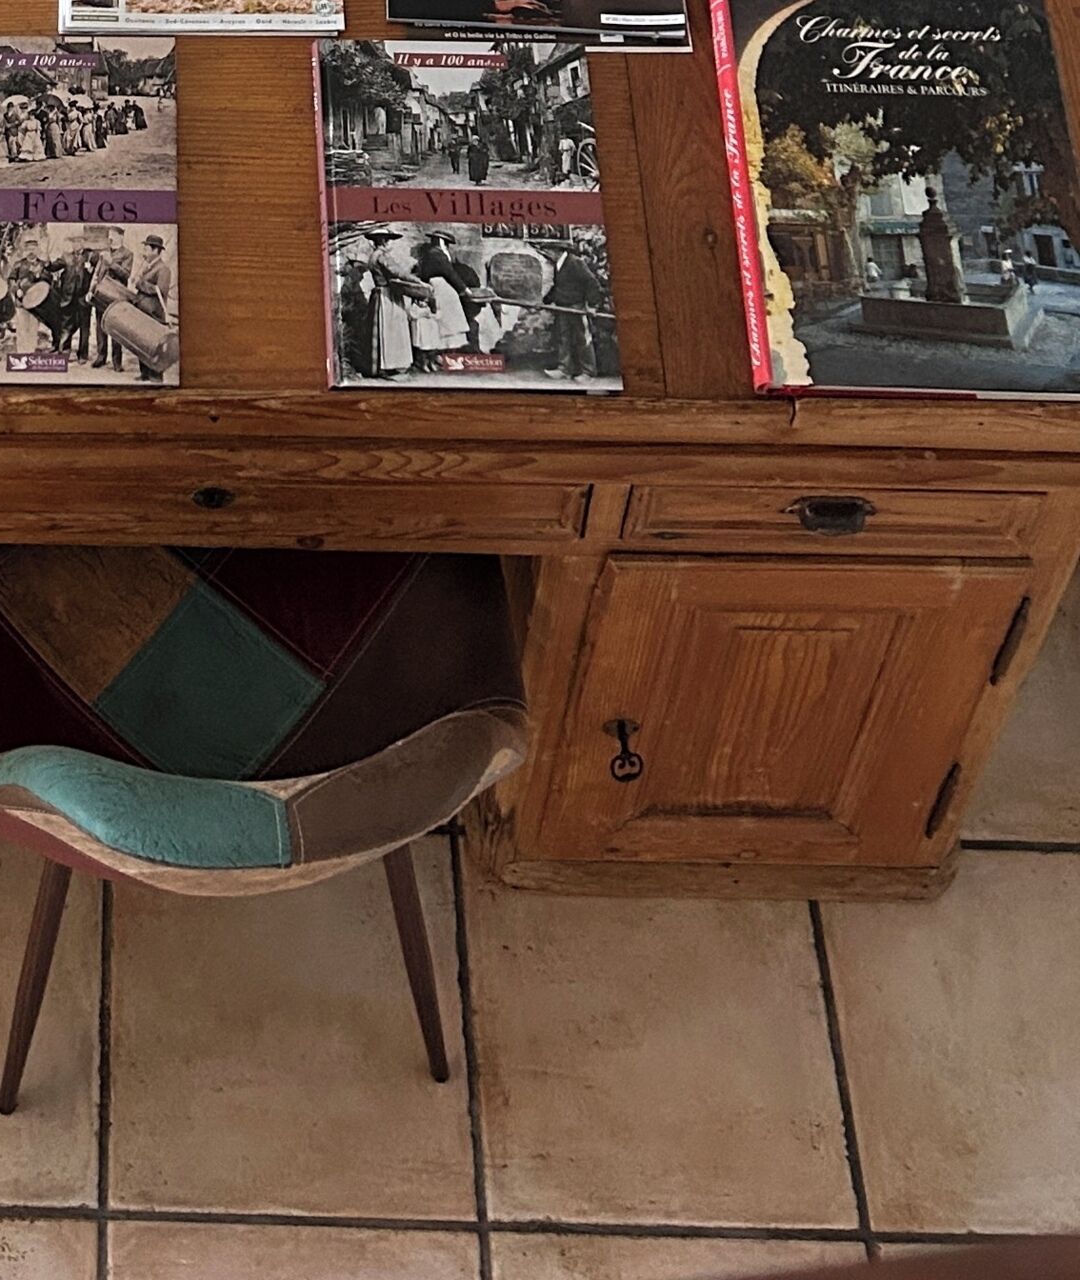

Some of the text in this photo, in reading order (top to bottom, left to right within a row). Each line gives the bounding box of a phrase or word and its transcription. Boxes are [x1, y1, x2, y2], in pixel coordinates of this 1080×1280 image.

[796, 14, 1002, 44] Charmes et secrets
[5, 58, 15, 68] y
[18, 58, 27, 67] a
[32, 54, 57, 67] 100
[396, 53, 410, 66] Il
[413, 56, 422, 68] y
[425, 56, 434, 66] a
[440, 54, 464, 66] 100
[832, 40, 973, 80] France
[898, 42, 951, 61] de la
[825, 81, 989, 97] ITINÉRAIRES & PARCOURS
[724, 88, 743, 164] France
[21, 190, 139, 222] Fêtes
[373, 191, 558, 222] Les Villages
